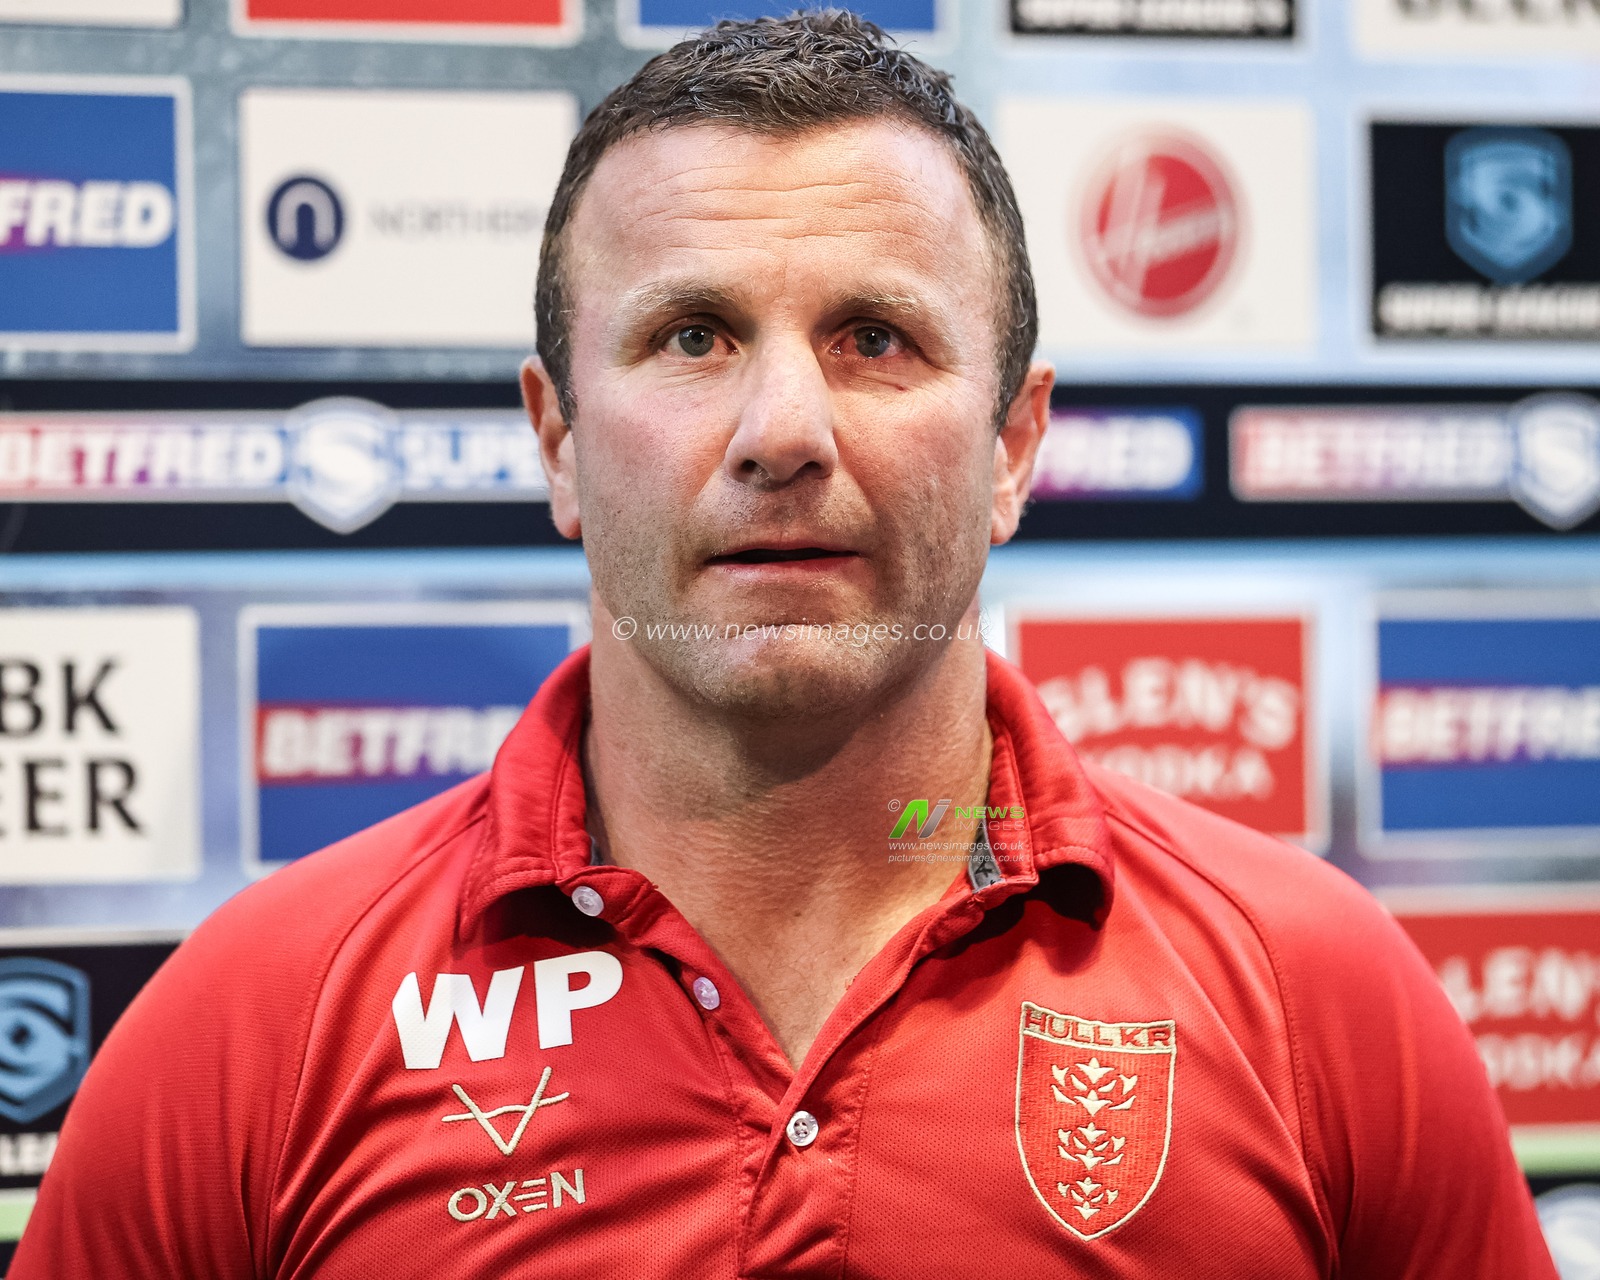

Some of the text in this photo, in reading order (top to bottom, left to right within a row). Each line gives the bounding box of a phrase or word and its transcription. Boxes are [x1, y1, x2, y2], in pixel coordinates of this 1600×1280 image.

[0, 756, 143, 838] ER
[391, 950, 624, 1070] WP
[1024, 1008, 1172, 1047] HULL KR
[447, 1168, 586, 1222] OXEN
